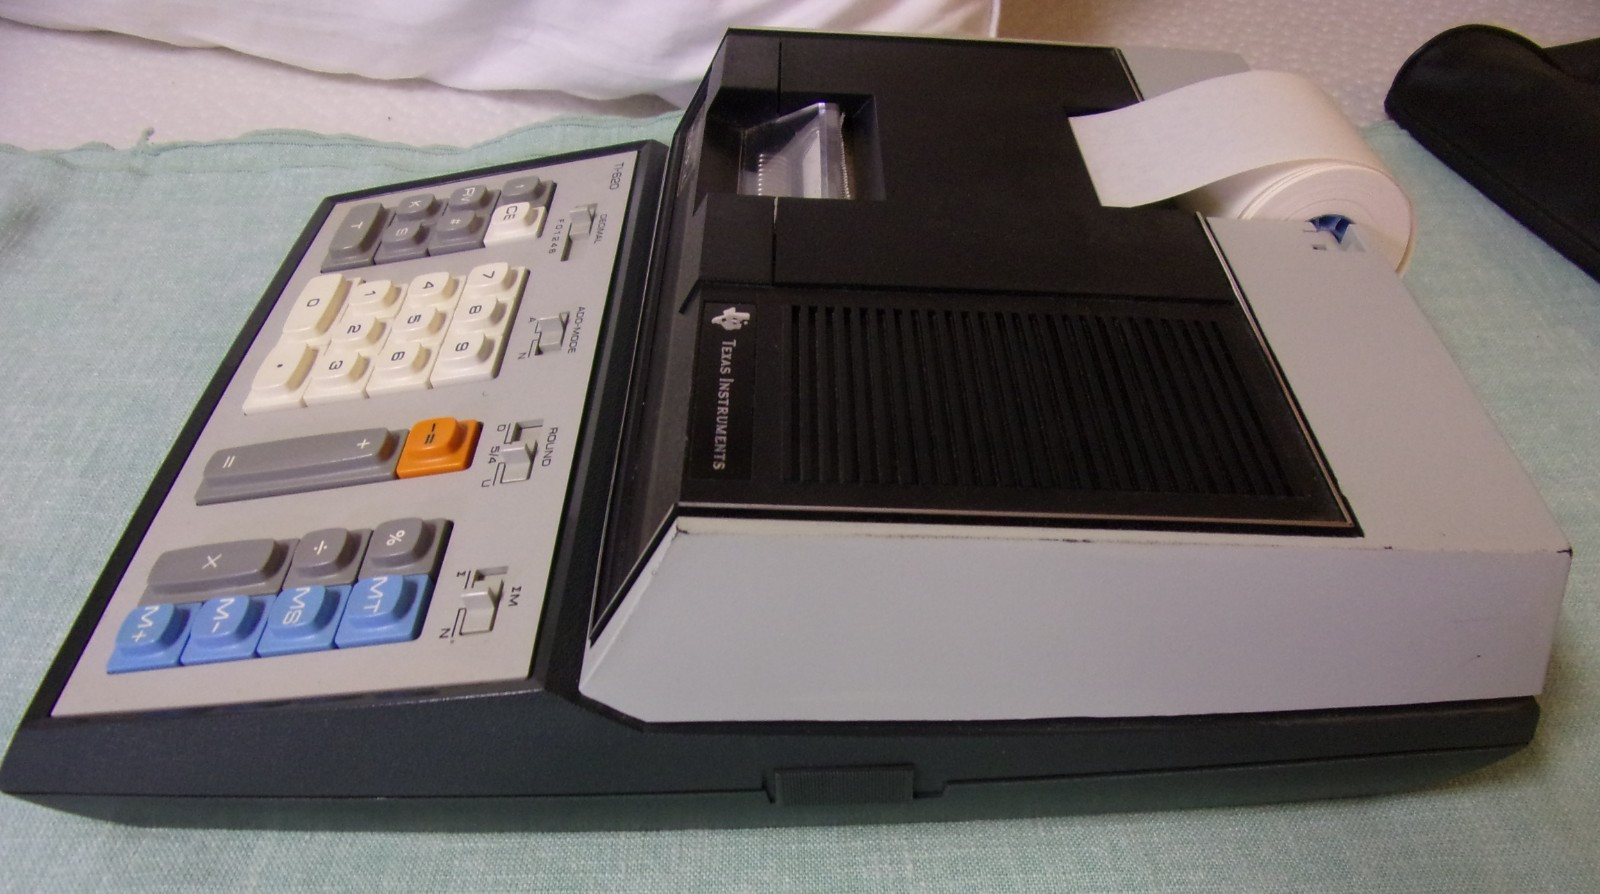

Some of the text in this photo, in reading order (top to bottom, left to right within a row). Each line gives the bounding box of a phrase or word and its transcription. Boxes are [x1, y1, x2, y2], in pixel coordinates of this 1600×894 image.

[609, 162, 624, 190] TI-620
[503, 205, 518, 221] CE
[350, 221, 363, 229] T
[593, 213, 608, 244] DECIMAL
[395, 227, 409, 236] S
[482, 270, 495, 279] 7
[423, 281, 434, 289] 4
[306, 298, 320, 307] 0
[468, 304, 482, 314] 8
[407, 314, 421, 324] 5
[347, 324, 361, 334] 2
[567, 306, 586, 354] ADD-MODE
[455, 341, 469, 352] 9
[391, 351, 405, 361] 6
[517, 352, 527, 360] N
[328, 360, 343, 370] 3
[712, 338, 737, 471] TEXAS INSTRUMENTS
[541, 427, 559, 467] ROUND
[488, 445, 501, 464] 5/4
[480, 479, 491, 488] U
[386, 529, 406, 547] %
[363, 576, 388, 613] MT
[282, 586, 311, 625] MS
[211, 597, 236, 633] M-
[131, 605, 160, 643] M+
[438, 627, 451, 639] N
